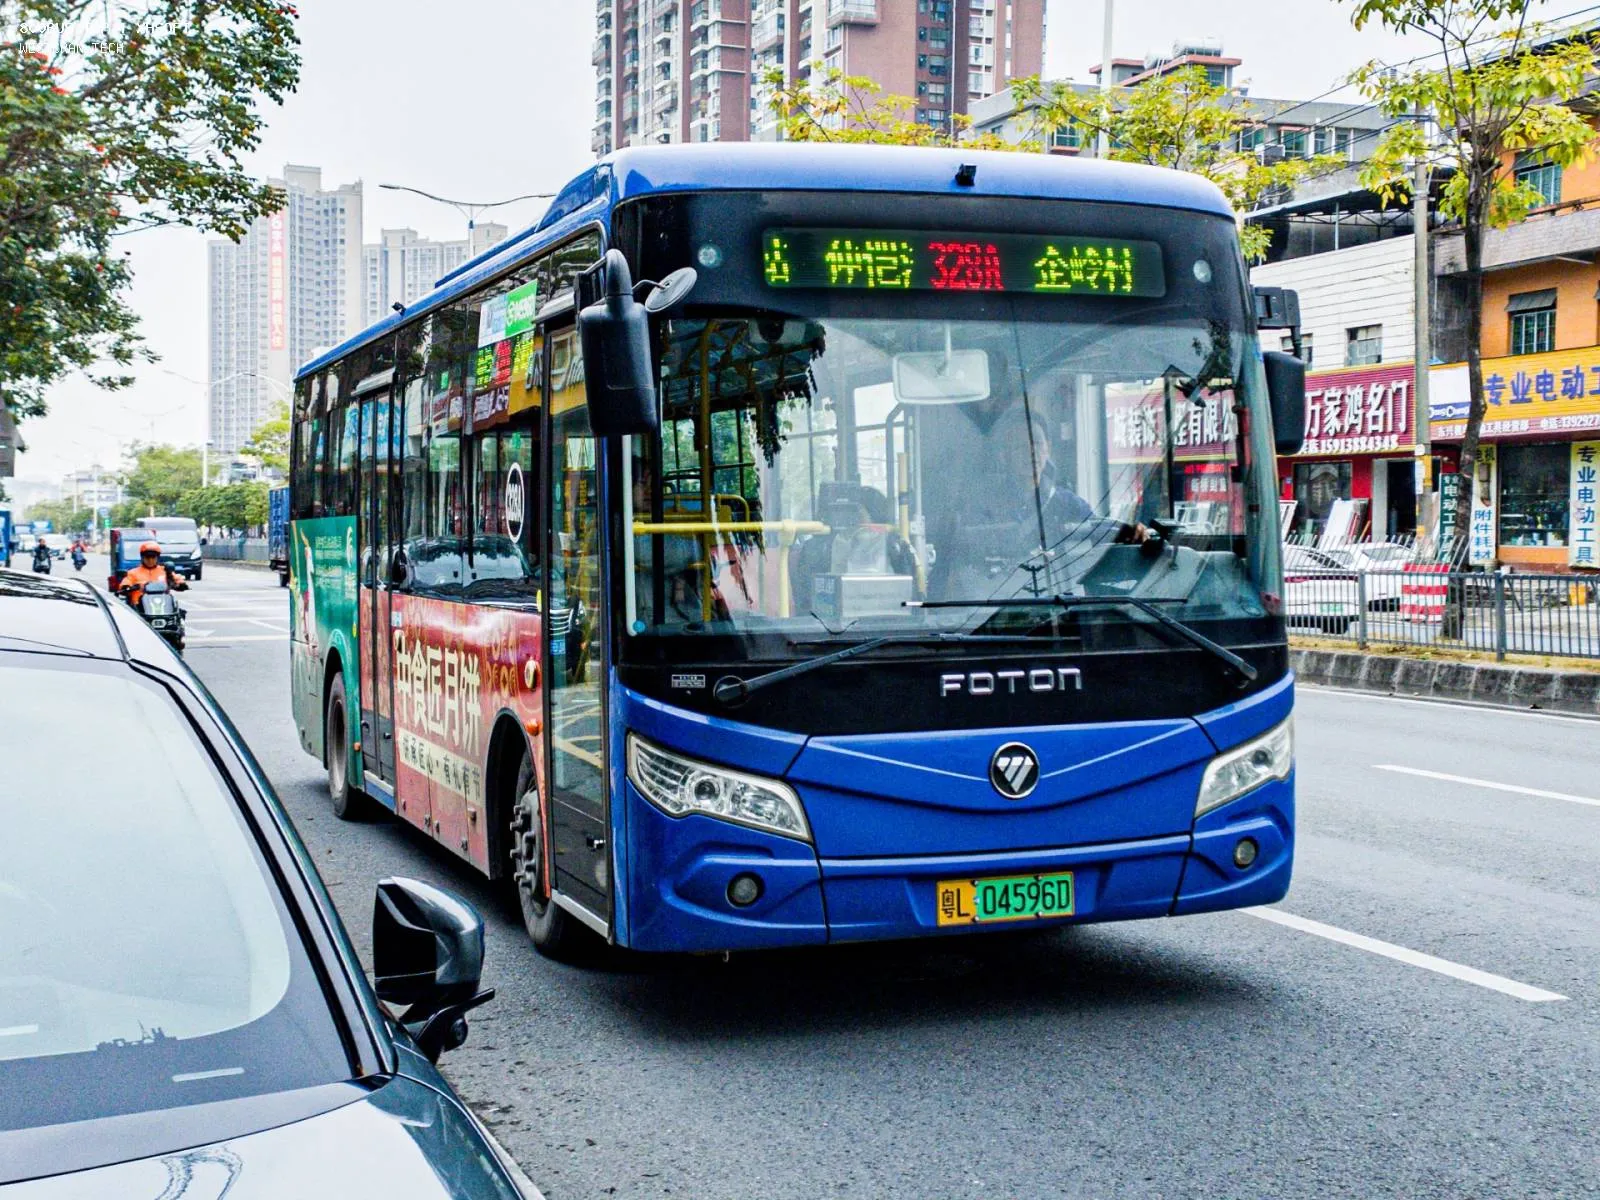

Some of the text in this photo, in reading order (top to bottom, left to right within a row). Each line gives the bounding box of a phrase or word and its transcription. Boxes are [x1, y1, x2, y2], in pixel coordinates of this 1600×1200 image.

[1576, 445, 1598, 563] 专业电动工具
[939, 667, 1083, 697] FOTON
[981, 878, 1071, 916] 04596D
